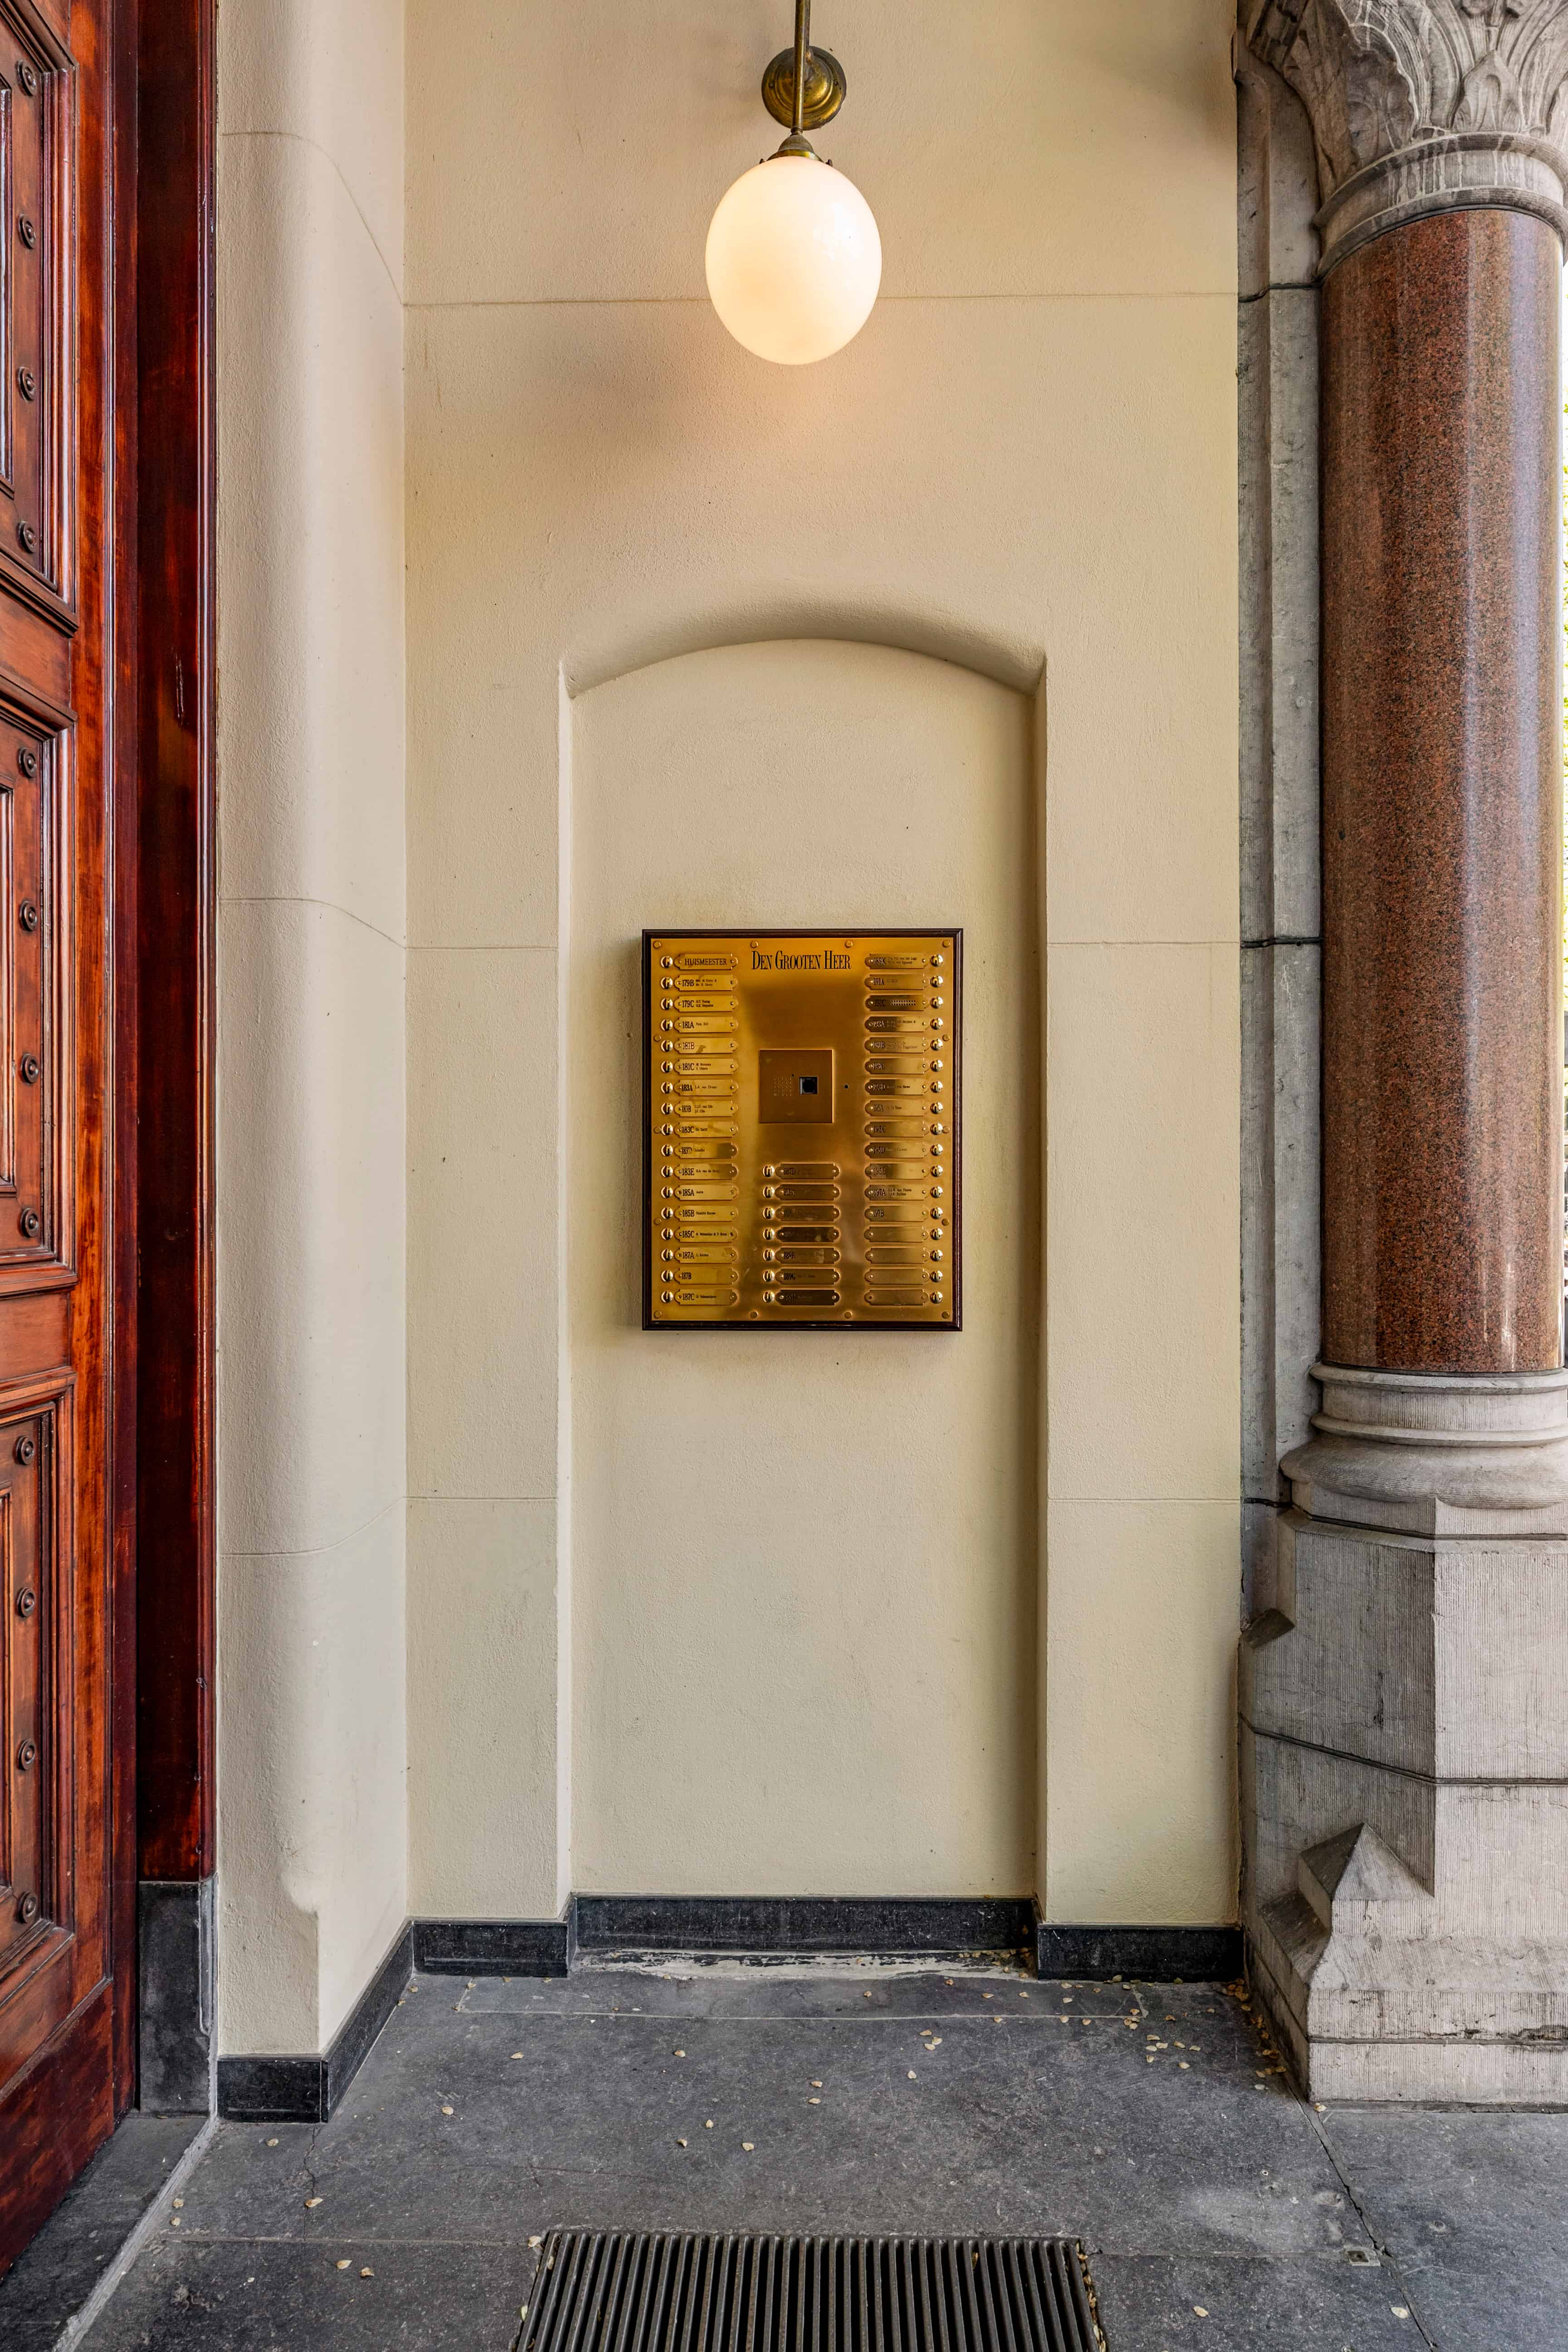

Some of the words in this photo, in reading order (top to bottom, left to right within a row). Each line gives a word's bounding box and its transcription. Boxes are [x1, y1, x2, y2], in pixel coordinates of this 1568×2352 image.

[874, 957, 886, 965] 189K
[682, 1188, 695, 1196] 185A
[682, 1209, 695, 1217] 185B
[682, 1230, 695, 1238] 185C
[682, 1293, 695, 1301] 187C
